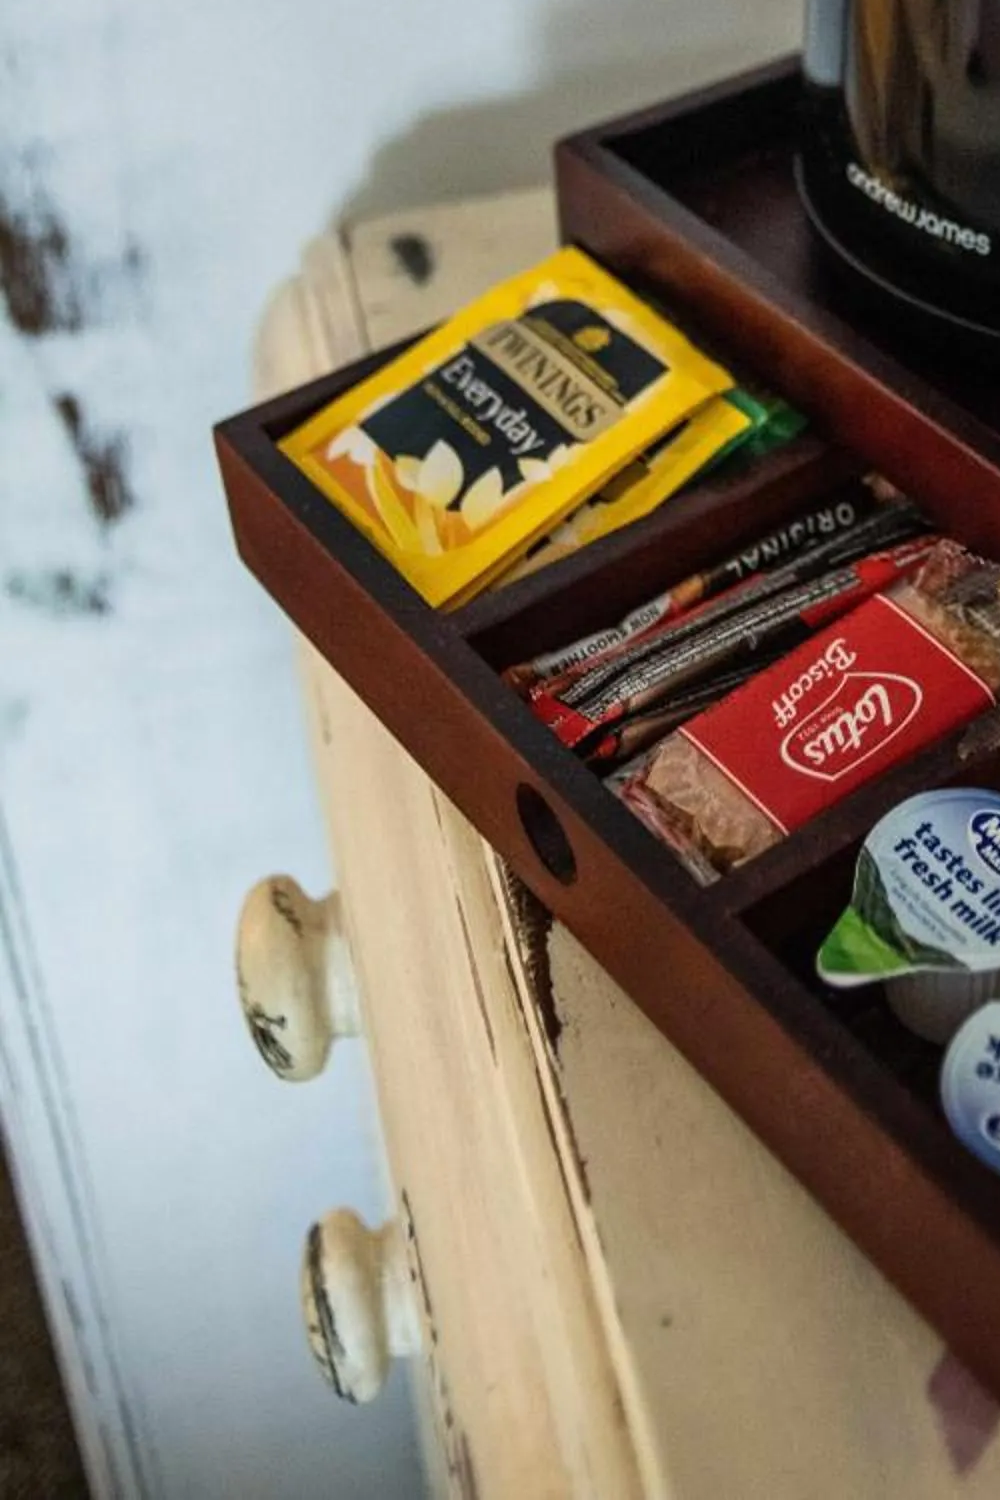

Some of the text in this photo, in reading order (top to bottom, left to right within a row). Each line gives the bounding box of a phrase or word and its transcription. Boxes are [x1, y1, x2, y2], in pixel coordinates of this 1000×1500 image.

[440, 356, 545, 455] Everyday
[487, 328, 602, 430] TWININGS
[772, 638, 857, 728] Biscoff
[803, 684, 893, 765] Lotus
[894, 837, 954, 902] fresh
[915, 821, 984, 895] tastes
